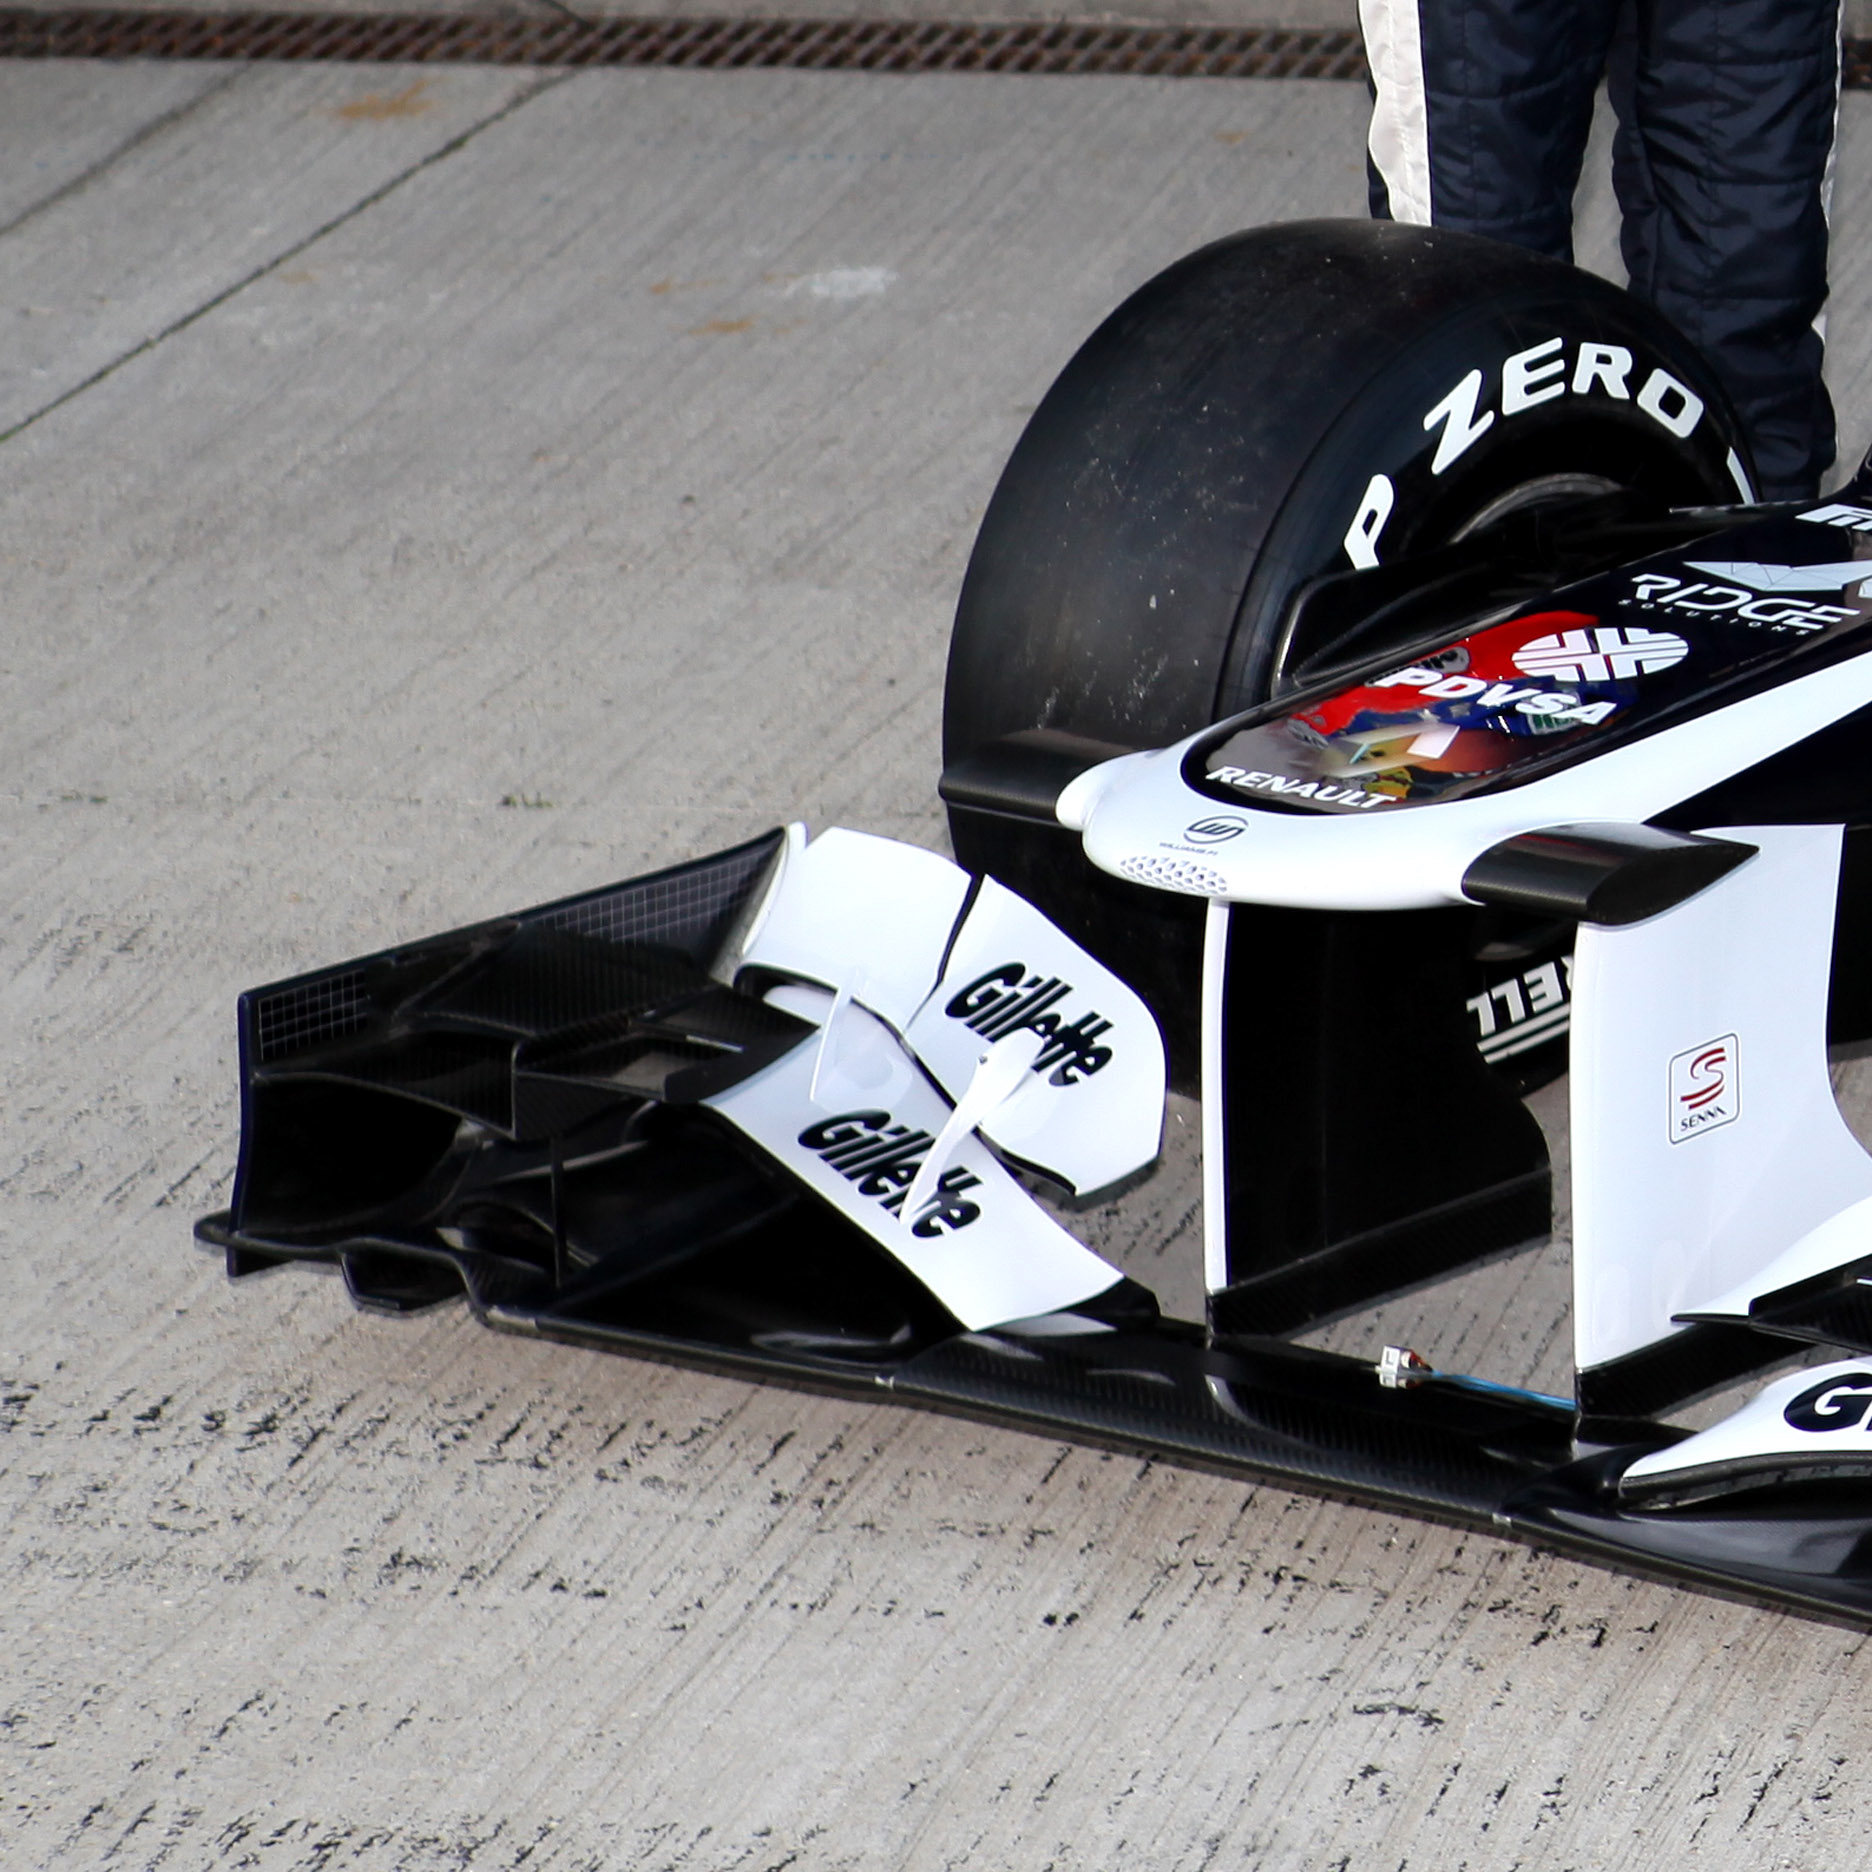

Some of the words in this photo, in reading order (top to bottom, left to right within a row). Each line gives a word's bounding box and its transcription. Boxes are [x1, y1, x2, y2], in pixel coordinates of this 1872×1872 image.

[1423, 337, 1704, 476] ZERO
[1617, 598, 1809, 637] SOLUTIONS
[1631, 573, 1861, 631] RIDGE
[1371, 666, 1618, 726] PDVSA
[1205, 765, 1398, 809] RENAULT
[944, 962, 1115, 1088] Gillette
